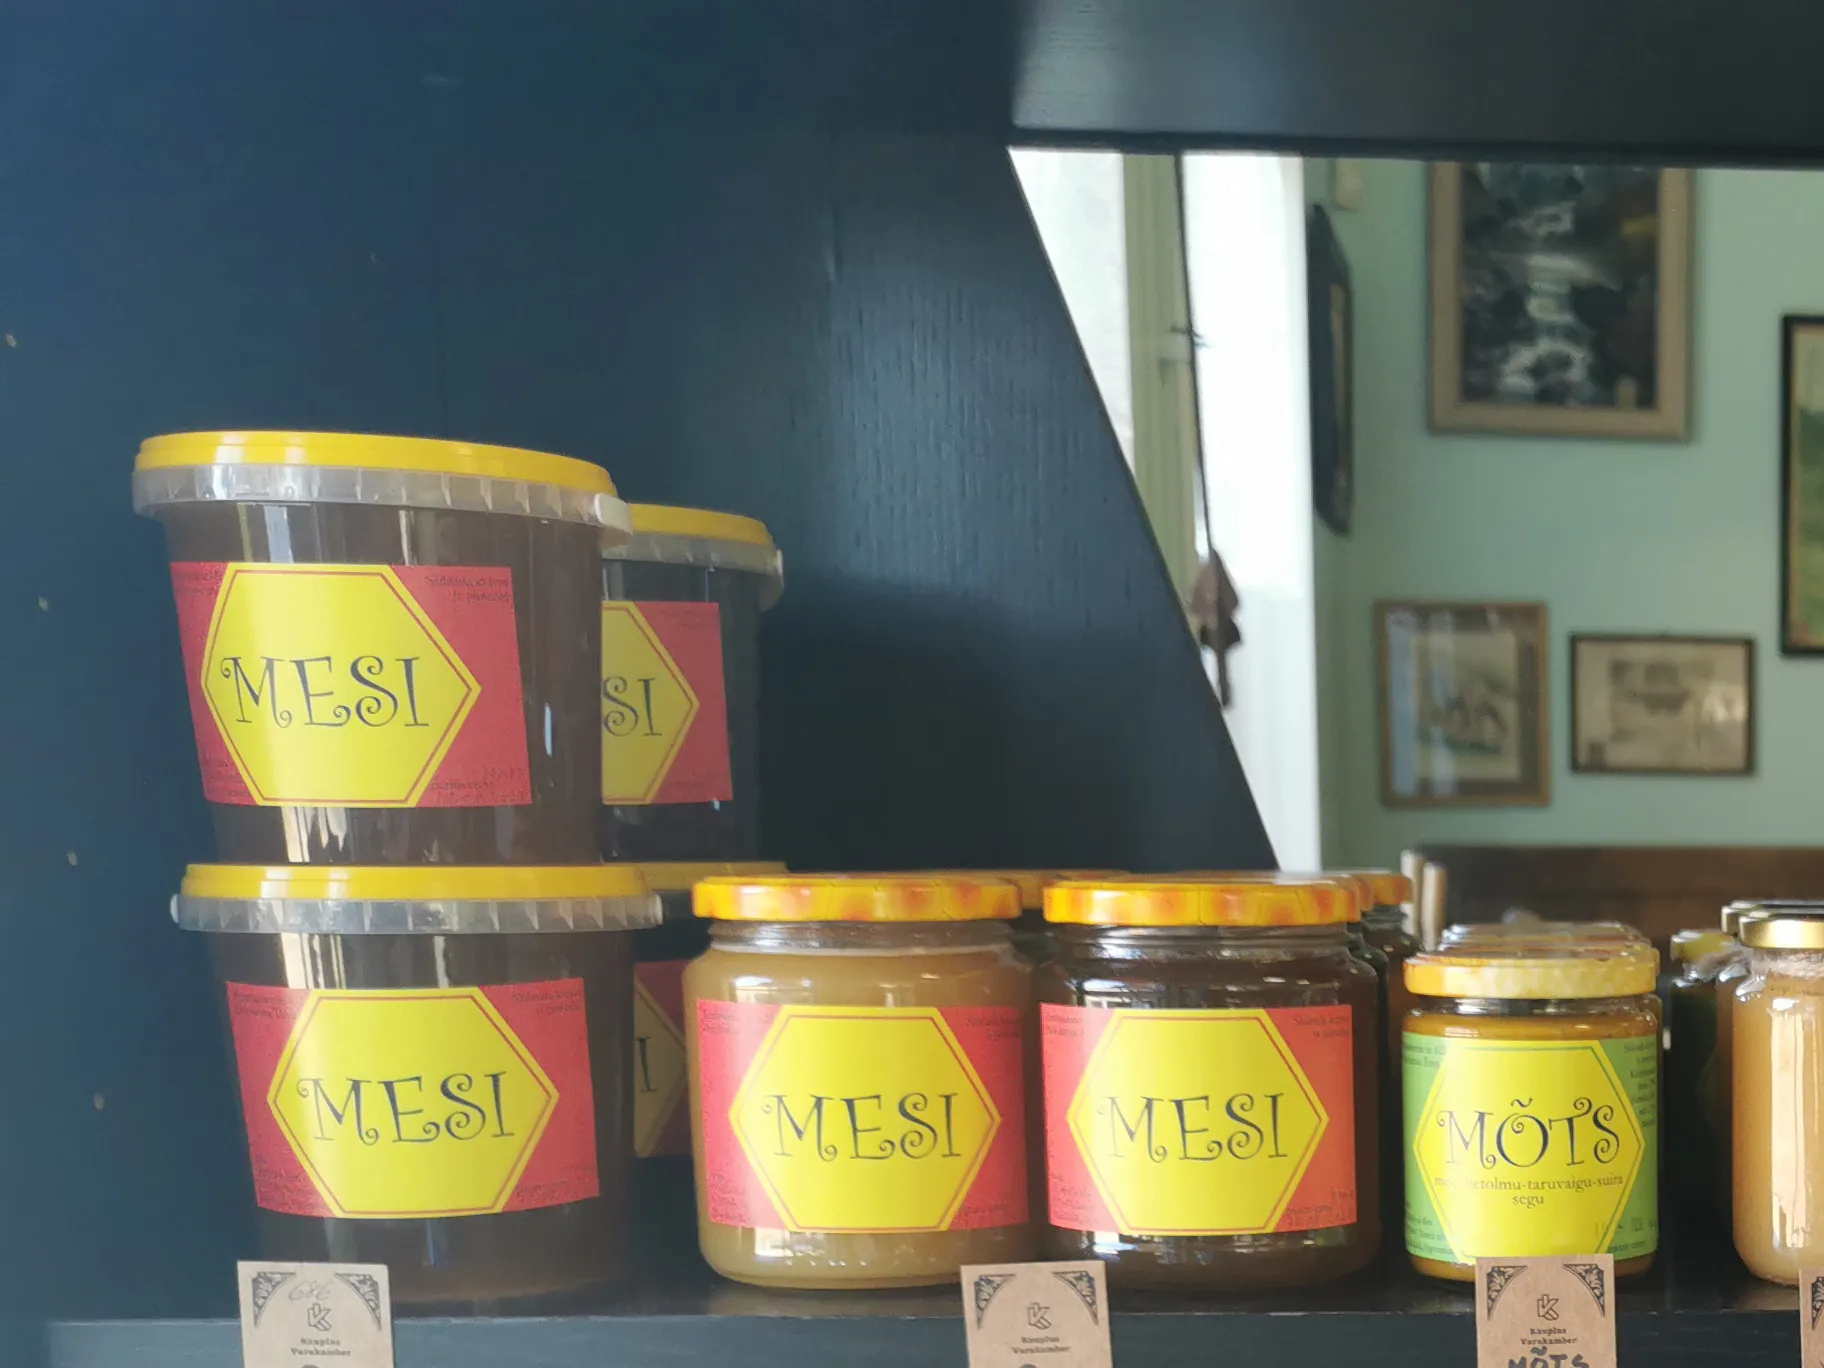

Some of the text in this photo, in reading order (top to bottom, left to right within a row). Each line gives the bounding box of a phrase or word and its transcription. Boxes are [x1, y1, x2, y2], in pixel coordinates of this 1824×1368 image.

[220, 655, 430, 729] MESI
[602, 676, 663, 738] SI
[296, 1071, 515, 1147] MESI
[761, 1092, 962, 1163] MESI
[1096, 1092, 1288, 1164] MESI
[1436, 1096, 1621, 1170] MÕTS
[1512, 1195, 1544, 1210] segu
[1529, 1326, 1567, 1336] Kauplus
